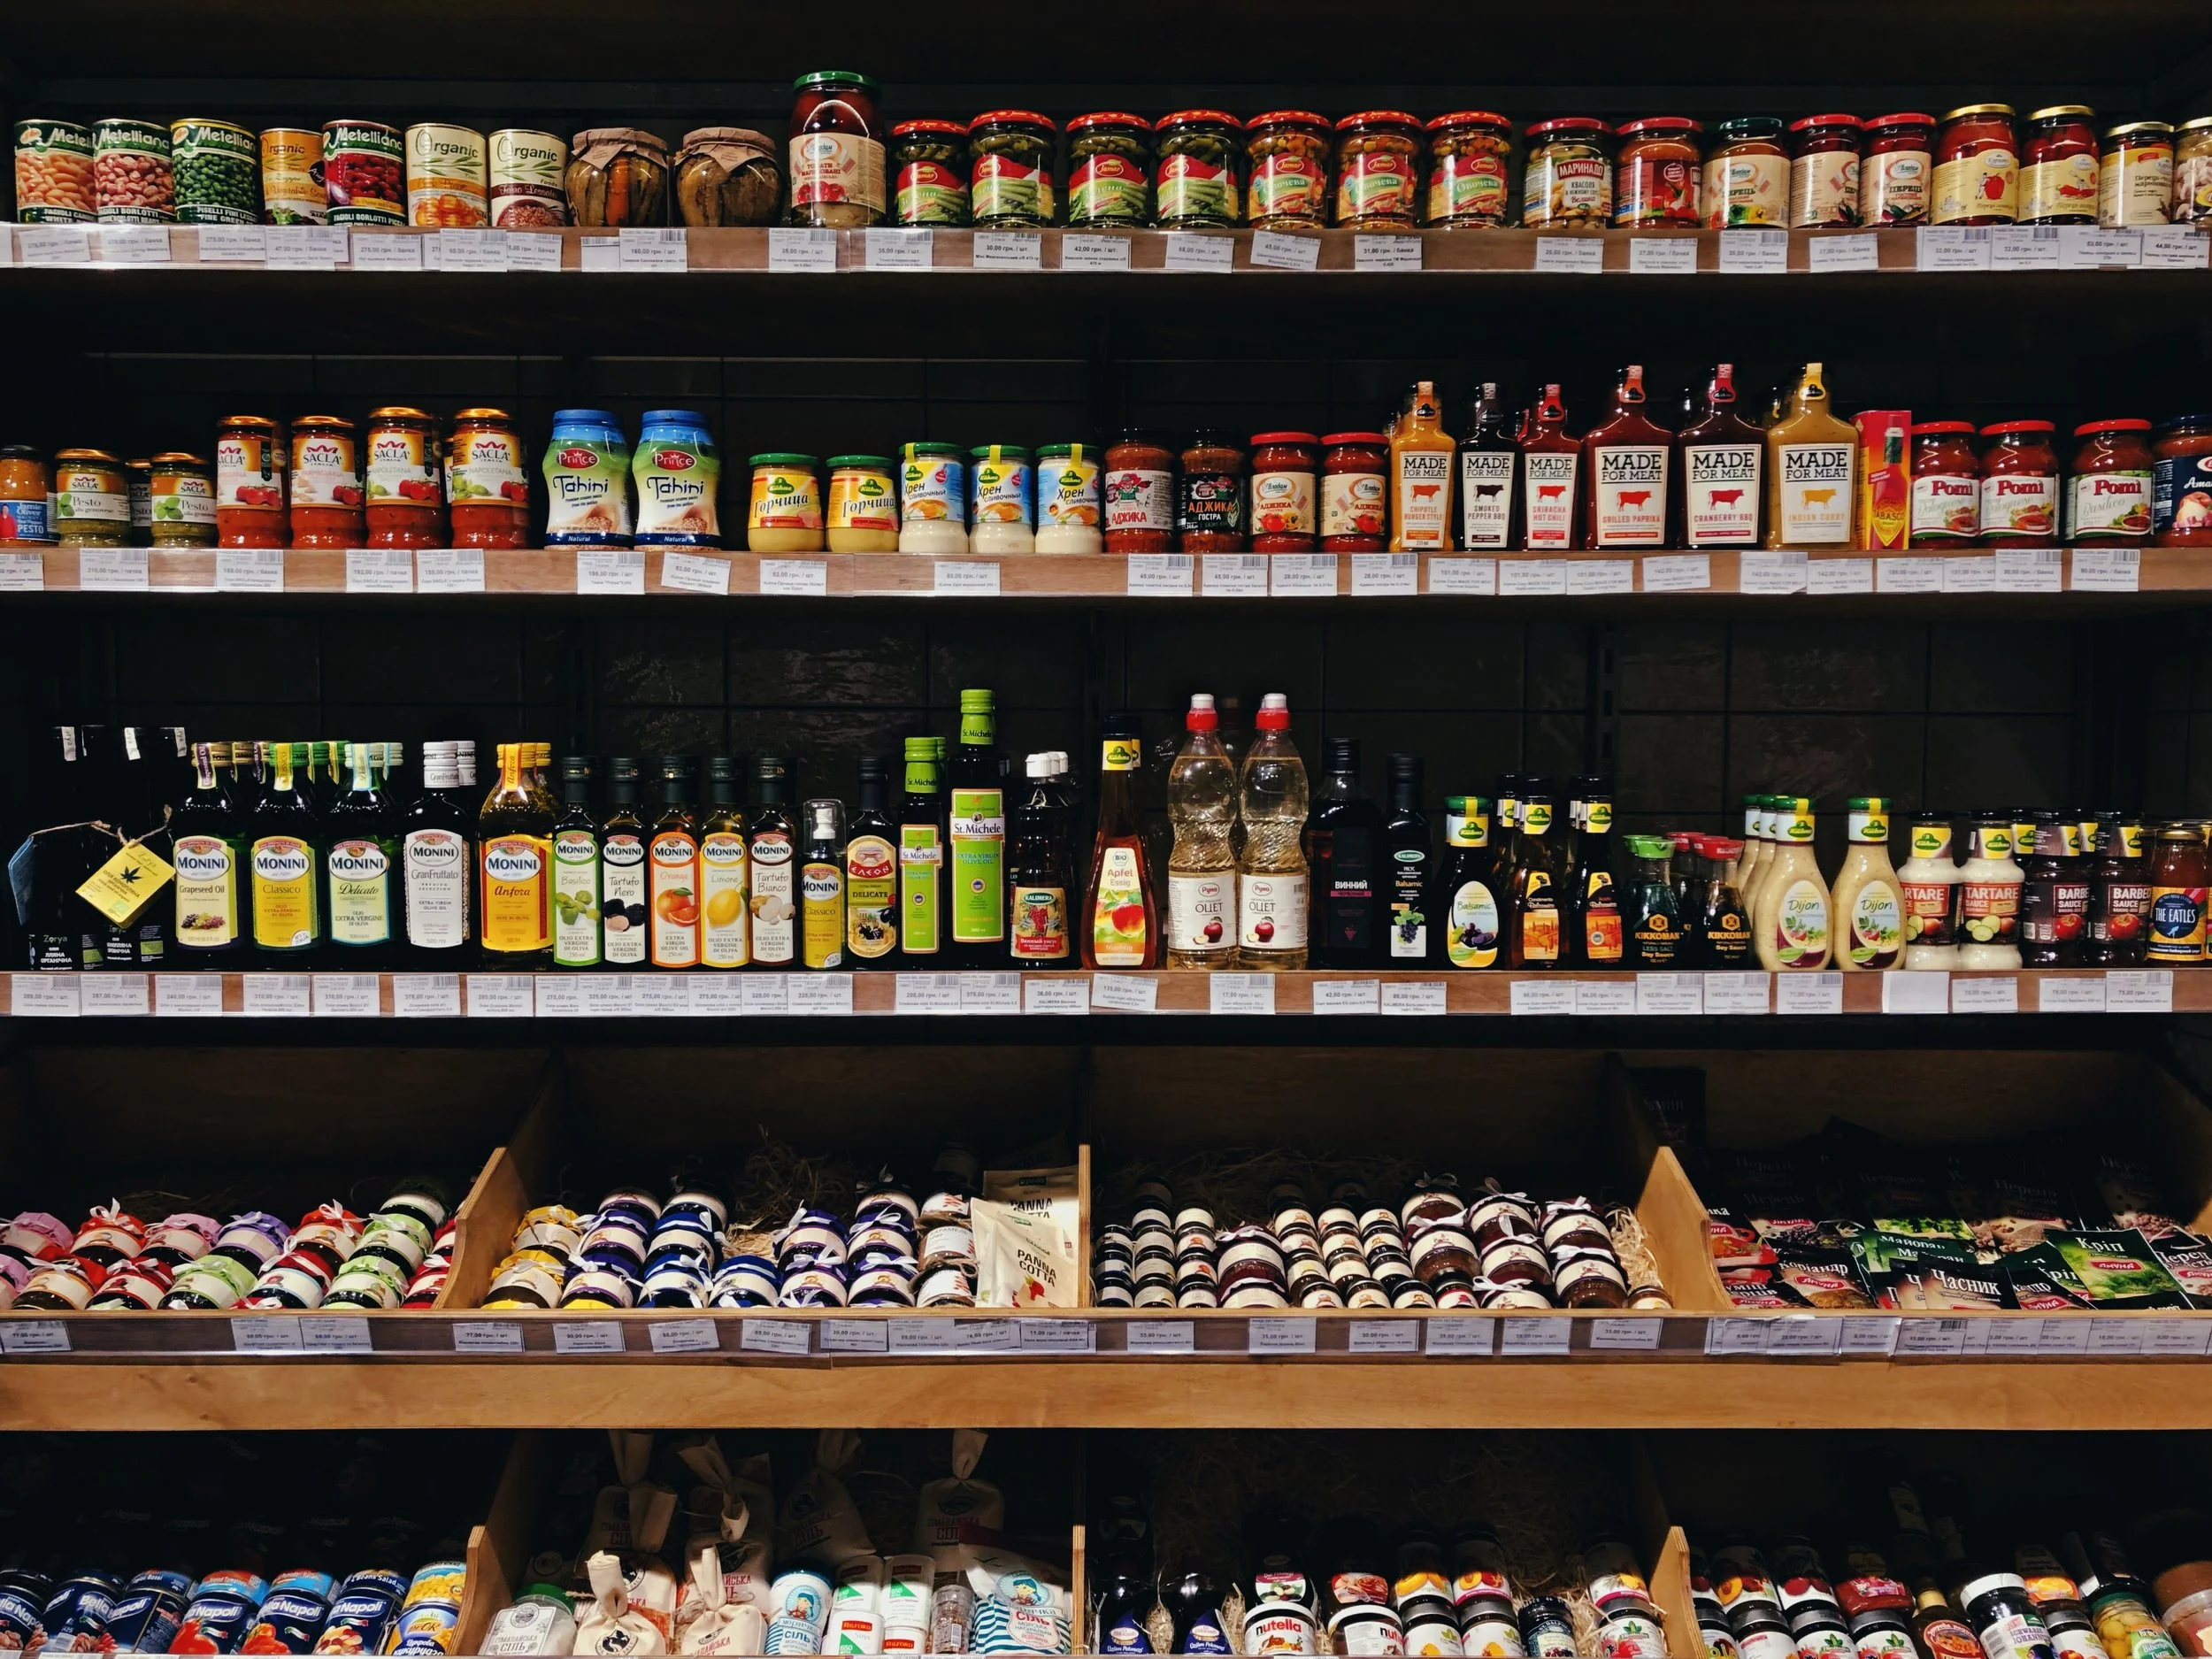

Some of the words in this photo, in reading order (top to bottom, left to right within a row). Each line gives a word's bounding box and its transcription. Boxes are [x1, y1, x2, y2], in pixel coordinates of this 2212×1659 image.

[416, 129, 479, 158] Organic
[1099, 165, 1120, 173] Jamar
[1279, 161, 1302, 170] Jamar
[1372, 161, 1395, 170] Jamar
[1474, 162, 1496, 171] Jamar
[1559, 162, 1604, 177] МАРИНАДО
[1888, 185, 1923, 194] ПЕРЕЦЬ
[558, 451, 596, 465] Prince
[655, 452, 694, 467] Prince
[1404, 457, 1447, 470] MADE
[1467, 457, 1509, 469] MADE
[1602, 455, 1662, 470] MADE
[1693, 453, 1754, 468] MADE
[1786, 452, 1847, 468] MADE
[1529, 459, 1572, 471] MADE
[1601, 471, 1628, 481] FOR
[1630, 471, 1663, 481] MEAT
[1693, 470, 1718, 480] FOR
[1721, 469, 1755, 478] MEAT
[1786, 469, 1811, 479] FOR
[1814, 468, 1848, 478] MEAT
[553, 475, 609, 500] Tahini
[647, 476, 703, 501] Tahini
[904, 482, 925, 495] Хрен
[978, 485, 1001, 499] Хрен
[910, 489, 946, 500] сливочный
[985, 493, 1021, 503] сливочный
[1057, 488, 1084, 501] Хрен
[73, 496, 101, 506] Pesto
[181, 501, 208, 511] Pesto
[755, 493, 809, 518] Горчица
[1188, 501, 1233, 513] АДЖИКА
[1112, 511, 1147, 523] АДЖИКА
[18, 525, 43, 534] PESTO
[956, 824, 964, 833] St.
[966, 824, 1001, 833] Michele
[413, 848, 455, 857] MONINI
[557, 845, 593, 854] MONINI
[606, 847, 641, 856] MONINI
[655, 847, 693, 856] MONINI
[706, 847, 741, 856] MONINI
[754, 846, 789, 855] MONINI
[177, 857, 225, 869] MONINI
[257, 857, 305, 870] MONINI
[331, 857, 384, 869] MONINI
[488, 858, 537, 870] MONINI
[411, 870, 458, 879] GranFruttato
[660, 872, 689, 881] Orange
[711, 874, 738, 883] Limone
[756, 872, 788, 883] Tartufo
[1108, 869, 1133, 879] Apfel
[561, 875, 591, 886] Basilico
[610, 876, 640, 886] Tartufo
[1335, 879, 1367, 889] ВИННИЙ
[180, 885, 213, 895] Grapeseed
[263, 885, 301, 894] Classico
[337, 883, 379, 895] Delicato
[495, 885, 530, 898] Anfora
[614, 887, 634, 897] Nero
[757, 883, 787, 892] Bianco
[803, 881, 839, 892] MONINI
[1964, 888, 2018, 900] TARTARE
[1195, 902, 1224, 913] ОЦЕТ
[1249, 902, 1276, 912] ОЦЕТ
[1788, 900, 1819, 911] Dijon
[1861, 900, 1893, 911] Dijon
[2155, 908, 2167, 922] THE
[2169, 907, 2196, 924] EATLES
[2078, 1237, 2125, 1252] Кріп
[1018, 1248, 1056, 1279] PANNA
[1779, 1262, 1848, 1276] Коріандр
[1018, 1261, 1055, 1287] COTTA
[1931, 1269, 2001, 1295] Часник
[378, 1575, 397, 1586] Salad
[196, 1606, 242, 1617] Napoli
[280, 1601, 320, 1616] Napoli
[341, 1601, 382, 1612] Napoli
[1015, 1610, 1050, 1626] СІЛЬ
[1256, 1617, 1302, 1636] nutella
[785, 1631, 810, 1644] СІЛЬ
